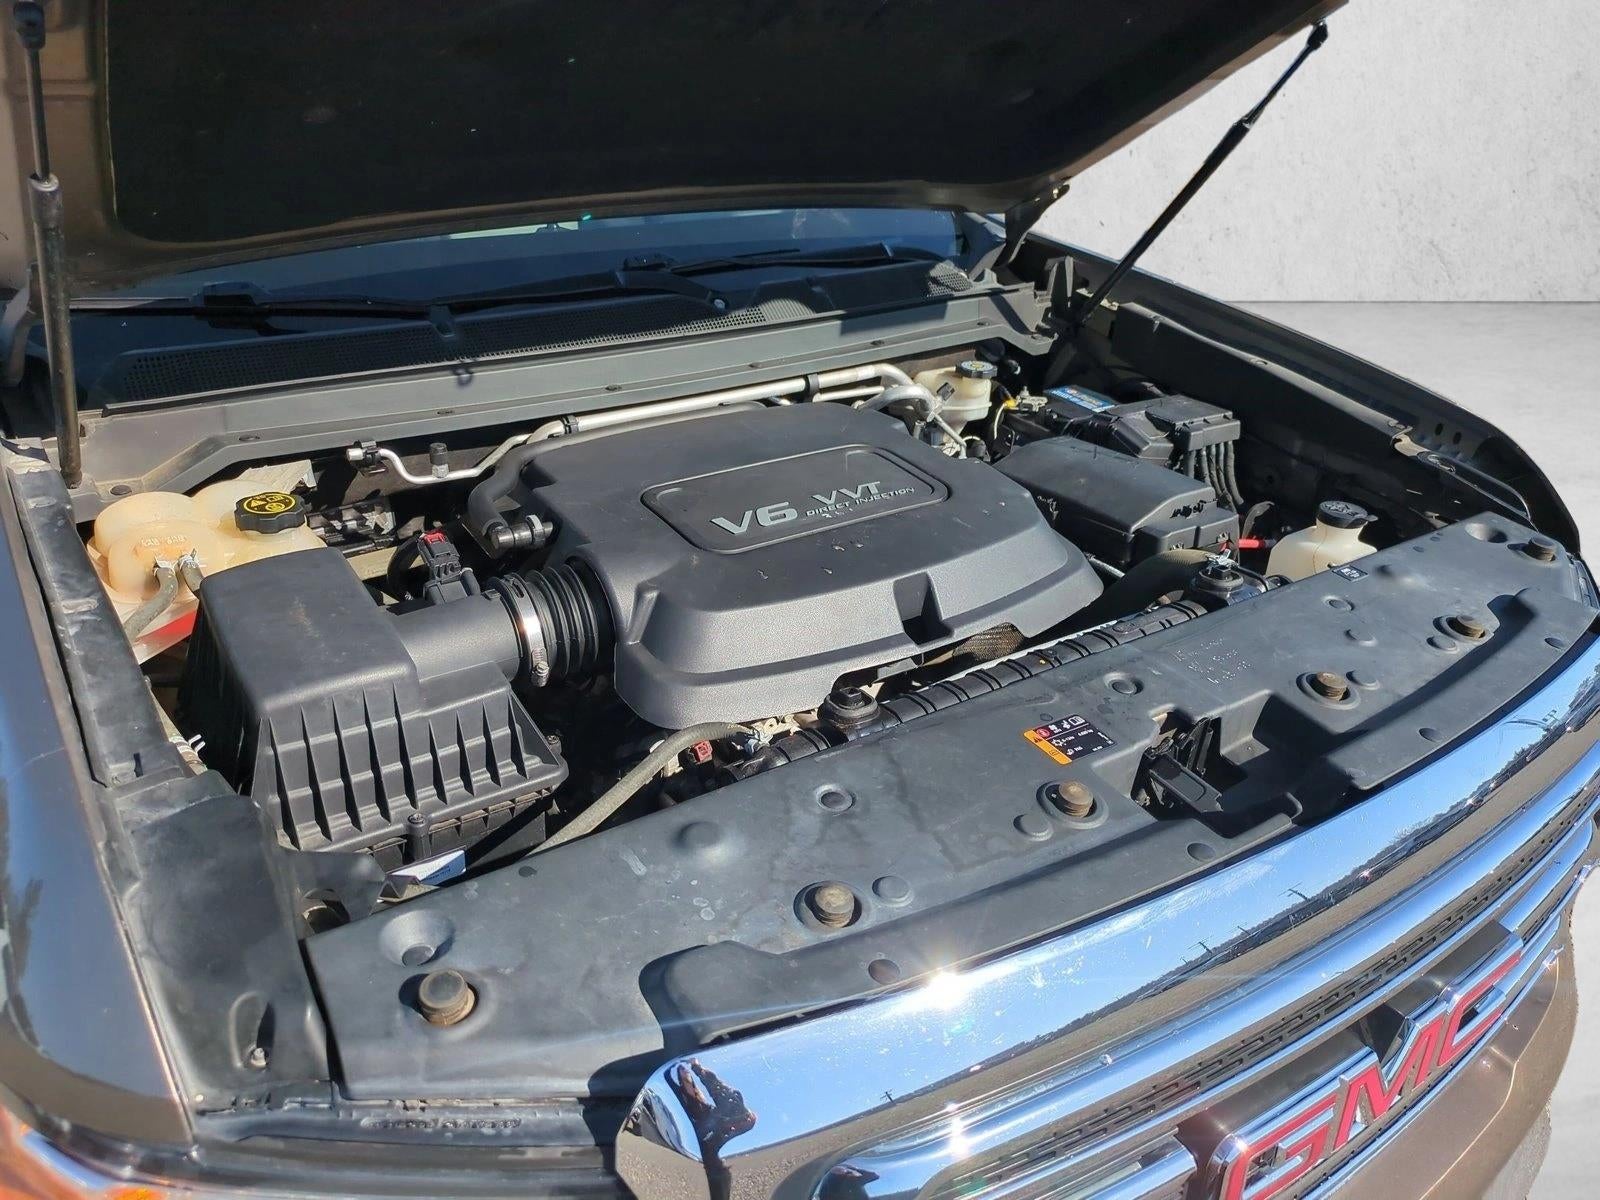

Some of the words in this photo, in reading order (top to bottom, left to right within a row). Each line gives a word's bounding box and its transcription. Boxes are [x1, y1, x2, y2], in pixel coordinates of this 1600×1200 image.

[806, 501, 851, 517] DIRECT
[855, 487, 915, 505] INJECTION
[812, 481, 881, 505] VVT
[710, 501, 798, 535] V6
[1220, 947, 1524, 1200] GMC
